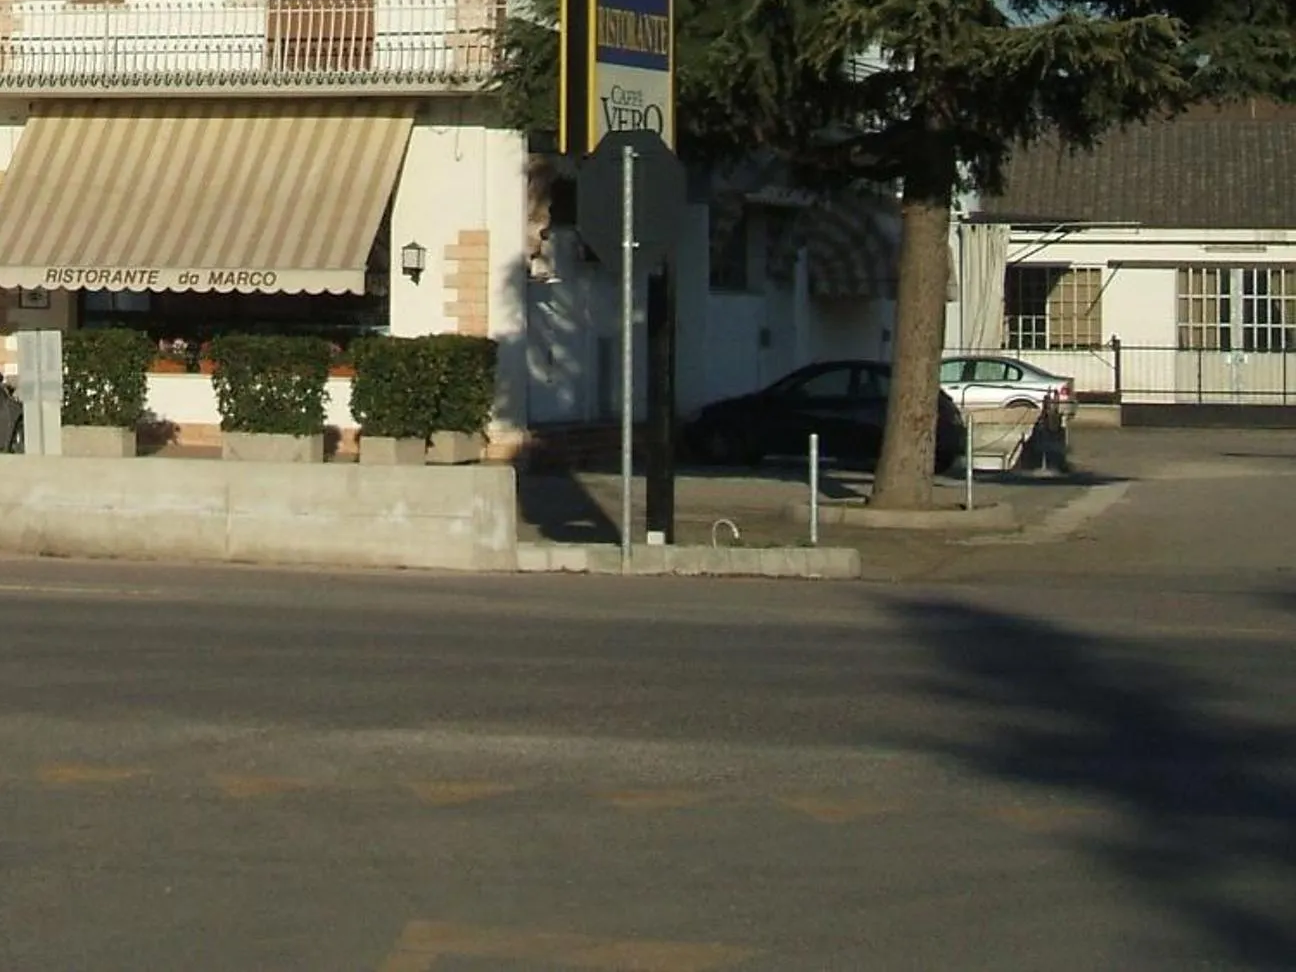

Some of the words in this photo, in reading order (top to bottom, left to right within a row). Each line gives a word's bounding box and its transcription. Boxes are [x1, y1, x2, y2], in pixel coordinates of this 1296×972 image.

[598, 6, 668, 55] RISTORANTE
[600, 97, 663, 135] VERO
[45, 268, 160, 285] RISTORANTE
[178, 271, 200, 285] da
[208, 271, 277, 287] MARCO
